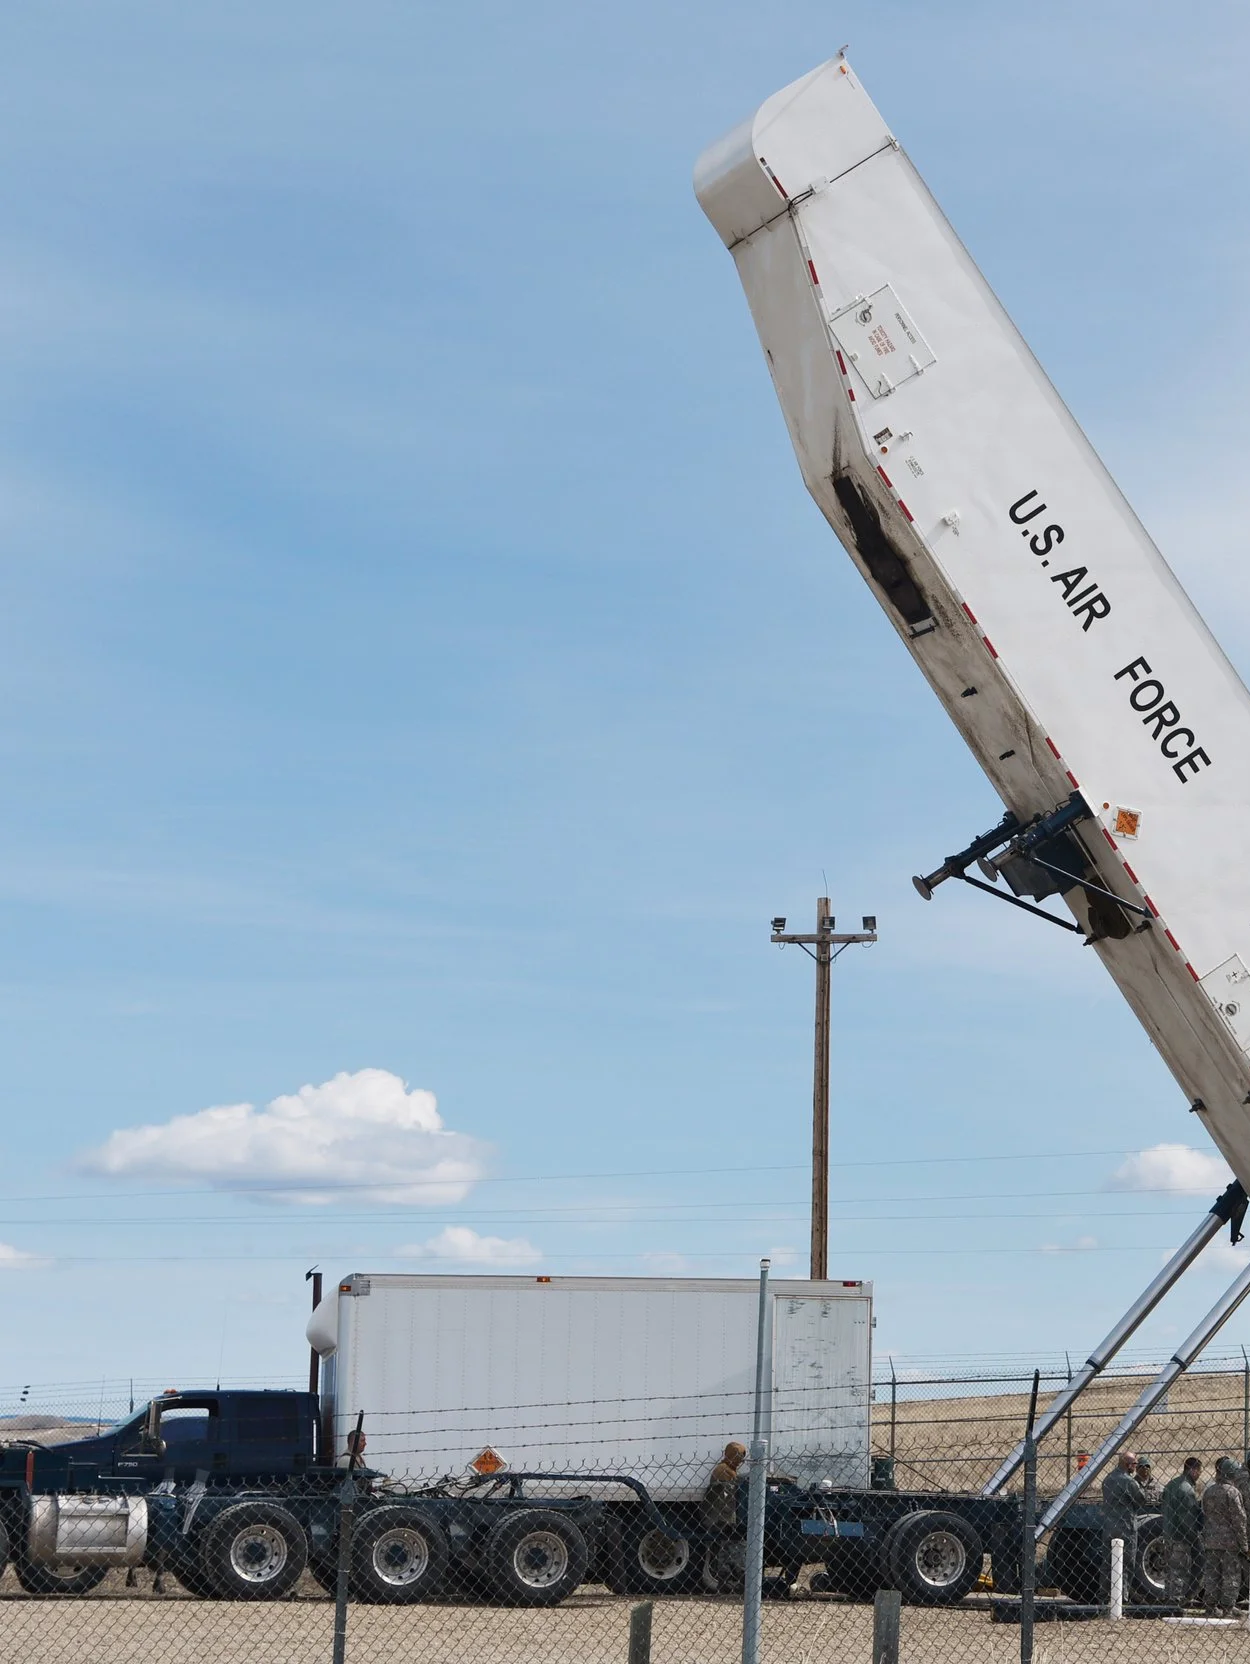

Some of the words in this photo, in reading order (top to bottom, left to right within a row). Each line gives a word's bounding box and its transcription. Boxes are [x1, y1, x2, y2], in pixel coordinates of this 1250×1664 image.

[1009, 490, 1064, 567] U.S.
[1051, 567, 1111, 632] AIR
[1114, 656, 1211, 784] FORCE
